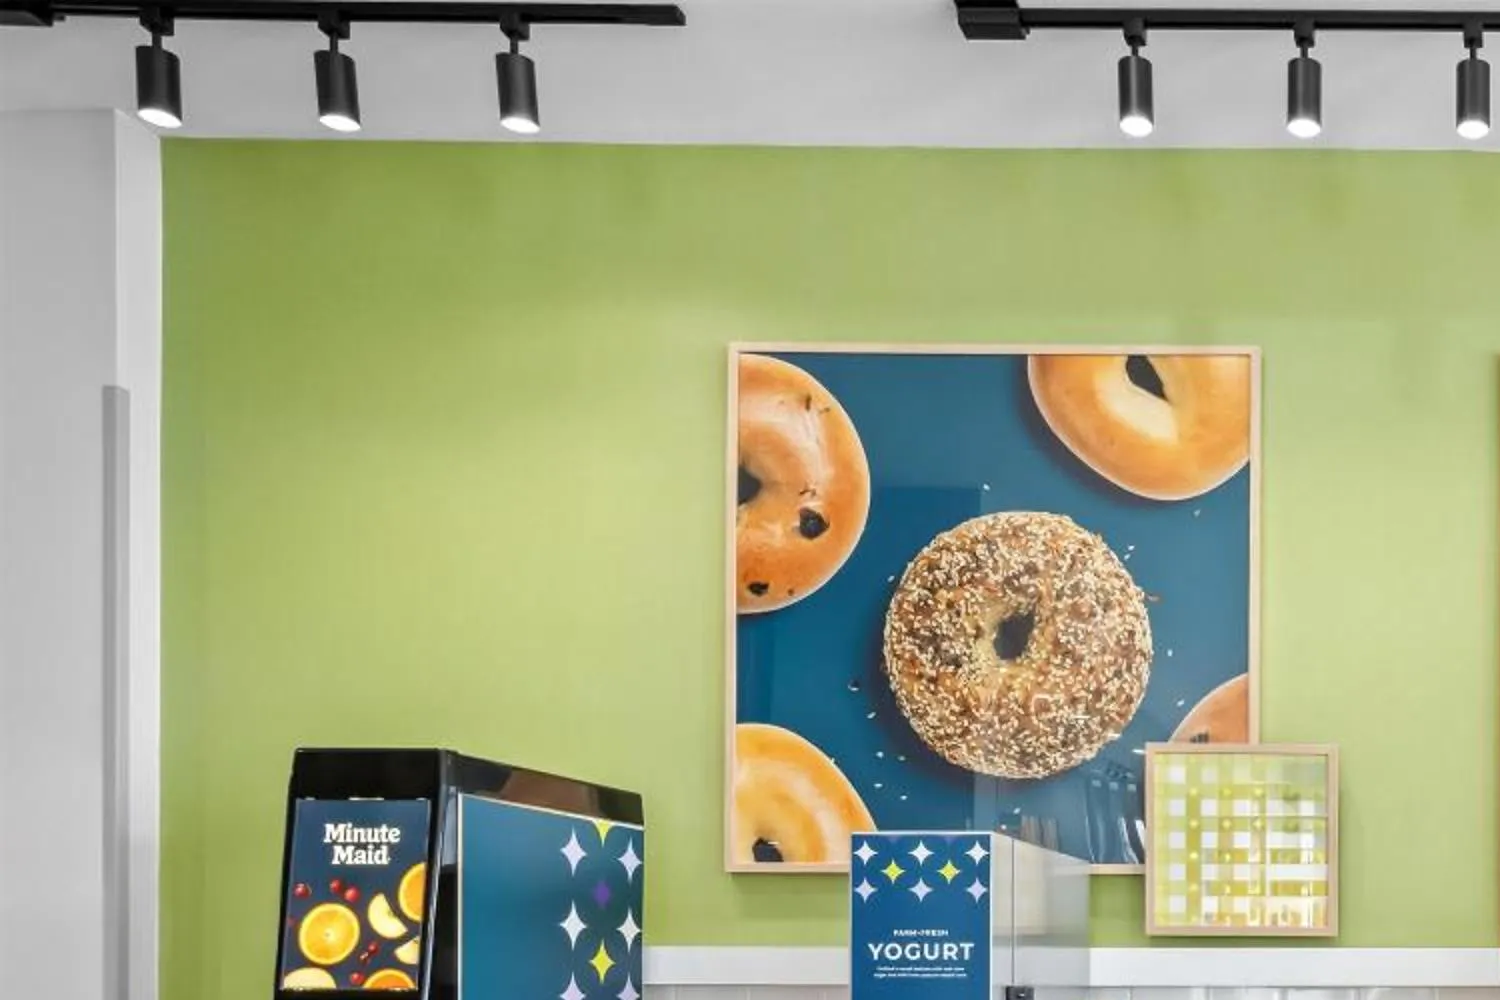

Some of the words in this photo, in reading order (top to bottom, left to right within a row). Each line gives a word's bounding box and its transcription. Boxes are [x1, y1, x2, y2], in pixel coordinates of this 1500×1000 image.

[323, 821, 402, 844] Minute
[331, 843, 391, 866] Maid
[867, 942, 976, 962] YOGURT
